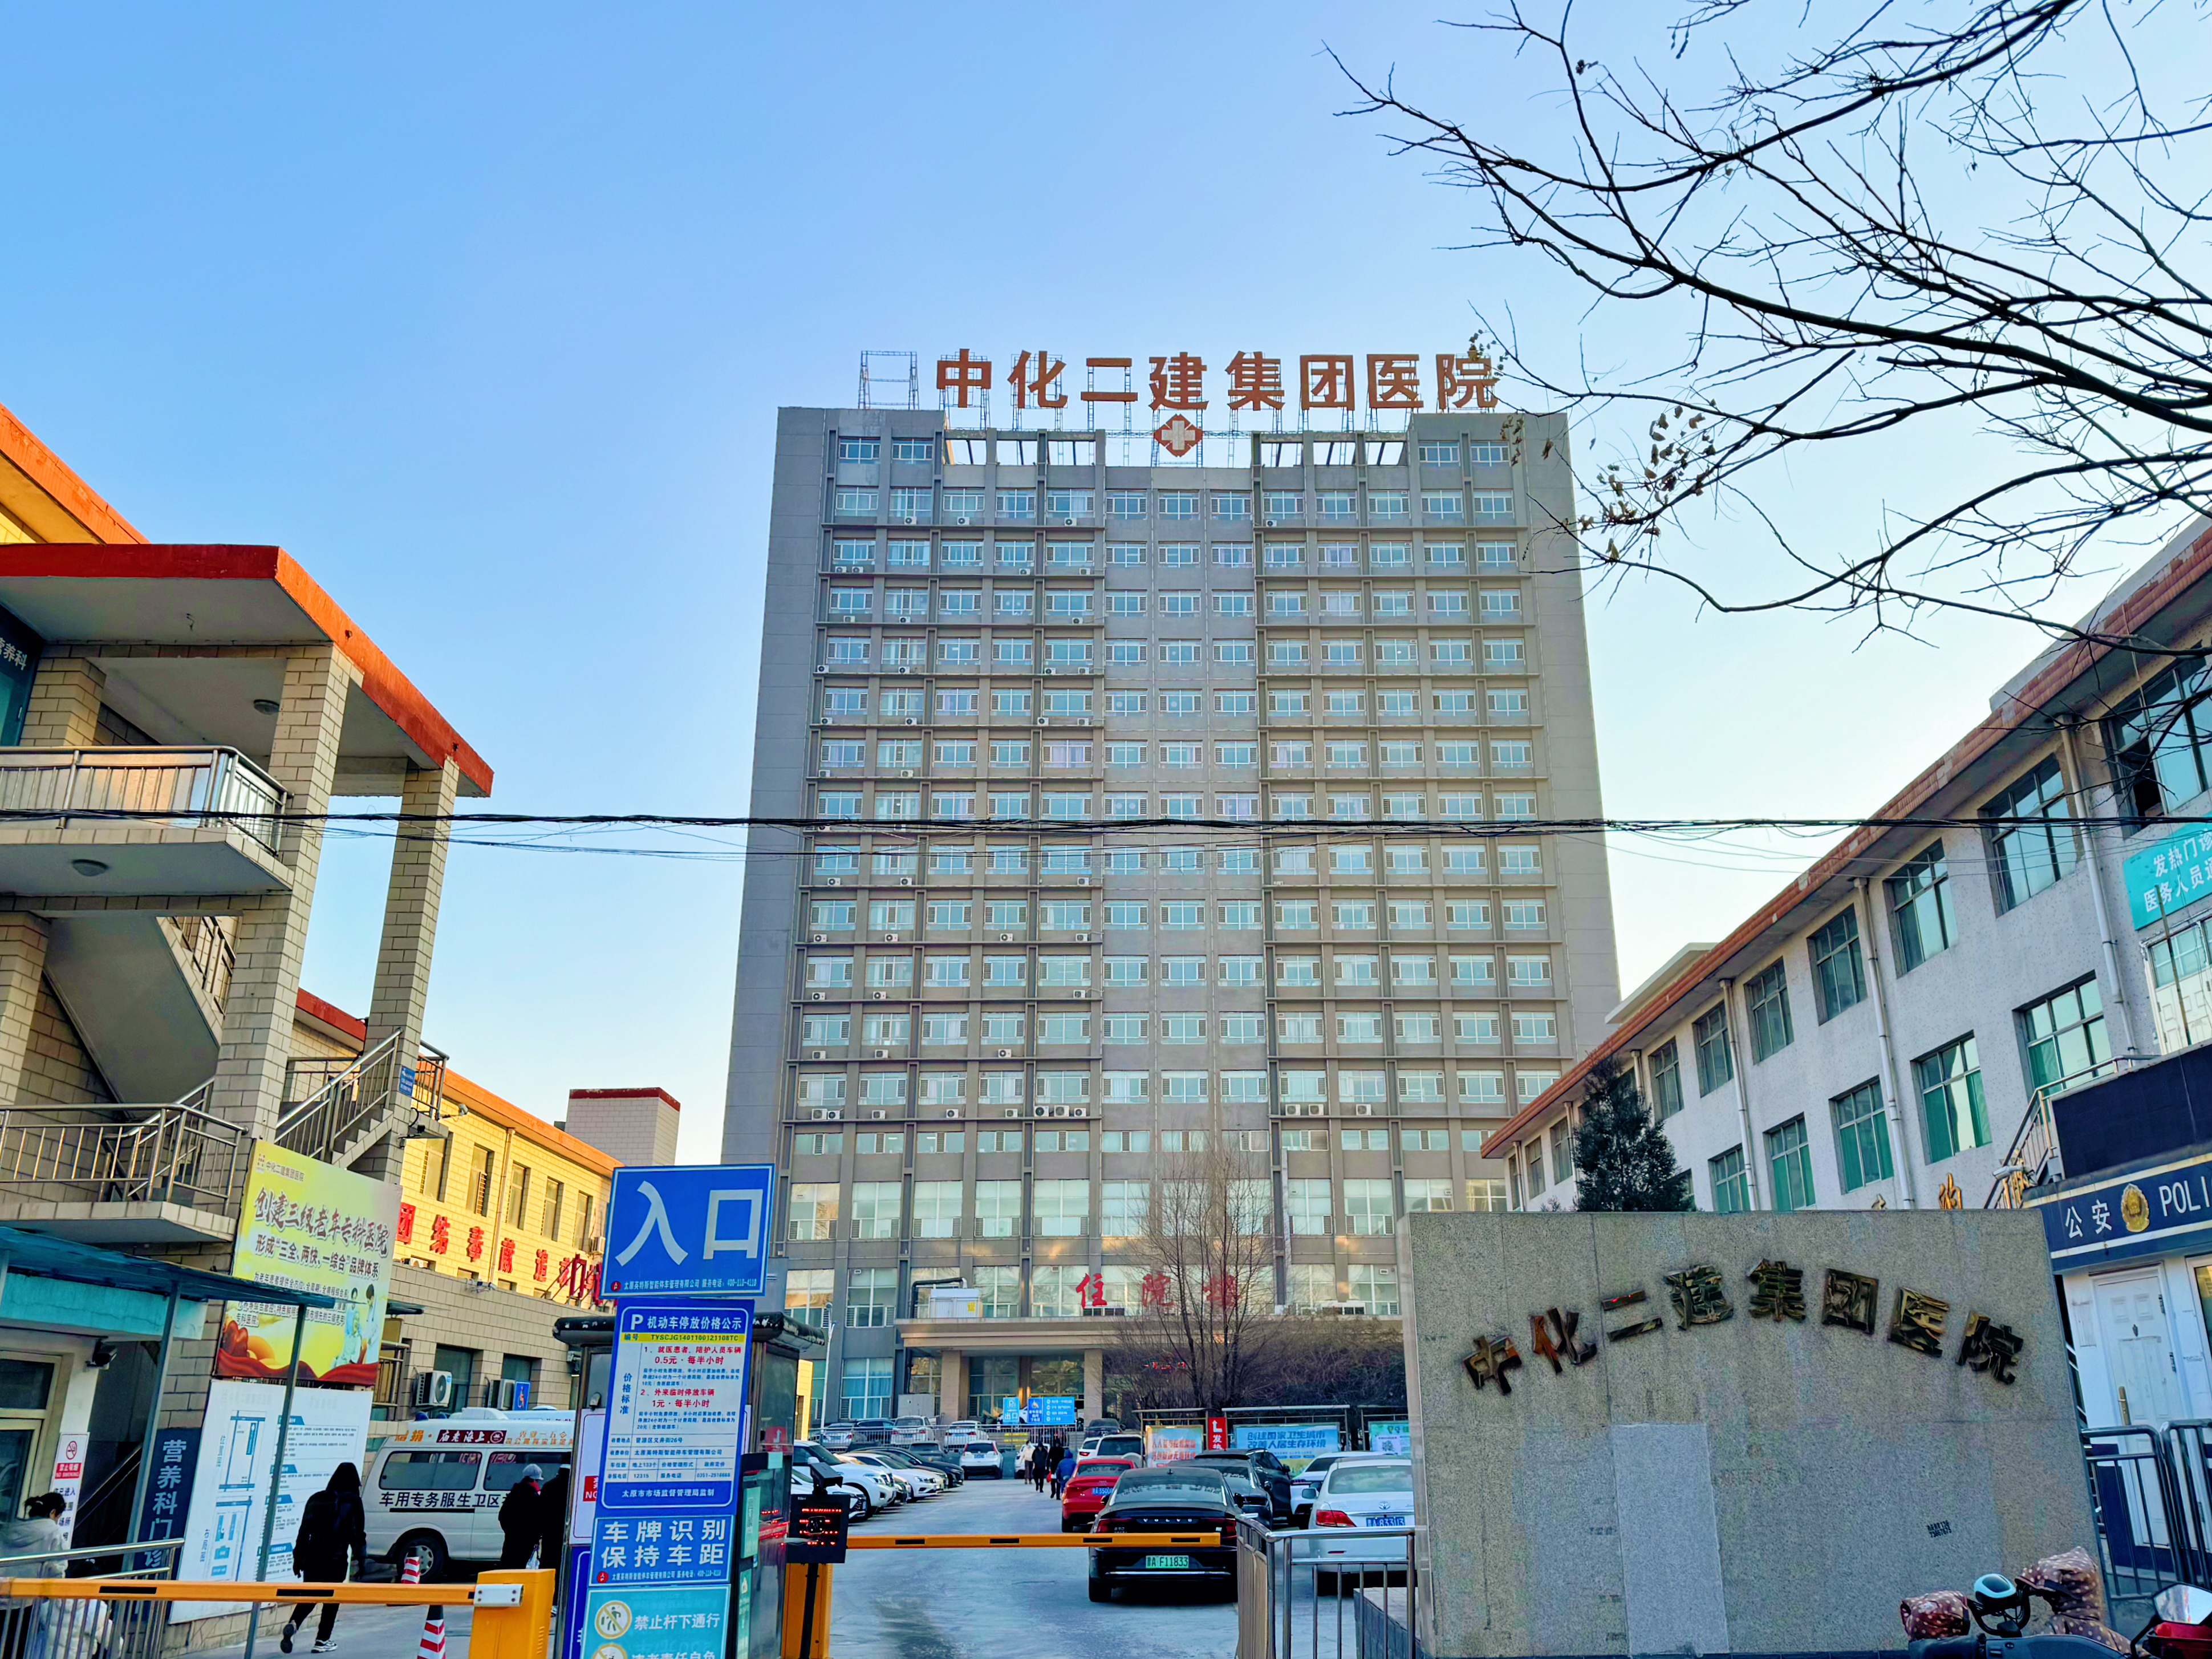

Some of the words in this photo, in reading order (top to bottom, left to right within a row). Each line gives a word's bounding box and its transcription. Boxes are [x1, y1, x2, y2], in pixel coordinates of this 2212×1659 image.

[936, 348, 1500, 410] 中化二建集团医院
[2153, 828, 2212, 878] 发热门诊
[266, 1160, 304, 1182] 中化二建集团医院
[2159, 1176, 2212, 1216] POLI
[255, 1187, 389, 1255] 创建三级老年专科医院
[615, 1181, 763, 1267] 入口
[2065, 1199, 2112, 1238] 公安
[647, 1316, 741, 1330] 机动车停放价格公示
[1462, 1258, 2024, 1396] 中化二建集团医院
[620, 1373, 632, 1414] 价格标准
[1248, 1431, 1325, 1441] 创建国家卫生城市
[144, 1439, 187, 1567] 营养科门诊
[622, 1489, 715, 1498] 太原市市场监督管理局监制
[602, 1519, 726, 1543] 车牌识别
[601, 1544, 725, 1568] 保持车距
[635, 1613, 720, 1630] 禁止杆下通行
